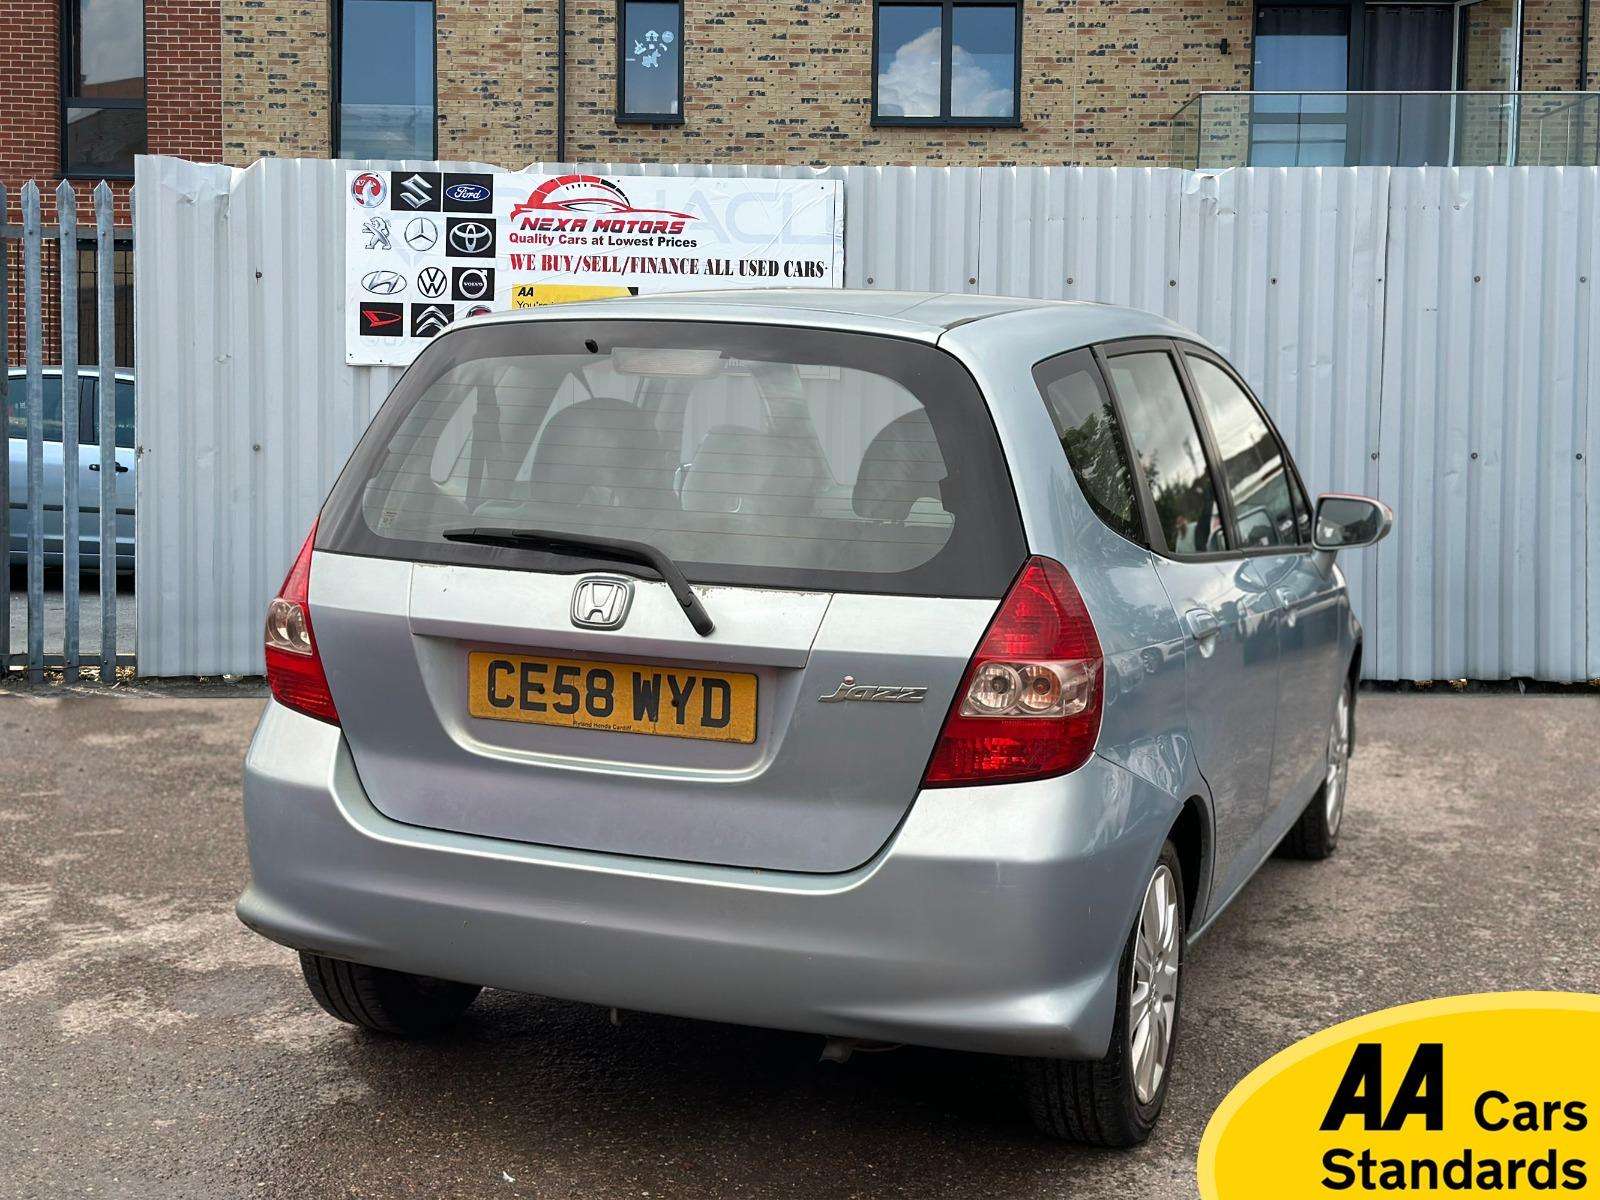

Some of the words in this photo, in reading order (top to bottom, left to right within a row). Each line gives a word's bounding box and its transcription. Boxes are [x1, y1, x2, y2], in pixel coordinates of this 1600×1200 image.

[454, 186, 481, 199] Ford
[520, 217, 587, 232] NEXA
[592, 219, 686, 235] MOTORS
[509, 233, 555, 247] Quality
[558, 235, 587, 246] Cars
[591, 236, 604, 246] at
[608, 236, 654, 247] Lowest
[657, 237, 697, 248] Prices
[509, 253, 536, 271] WE
[541, 254, 699, 276] BUY/SELL/FINANCE
[703, 258, 734, 276] ALL
[739, 259, 780, 277] USED
[783, 260, 825, 278] CARS
[517, 286, 534, 297] AA
[487, 660, 615, 718] CE58
[632, 671, 731, 729] WYD
[818, 675, 928, 703] jazz
